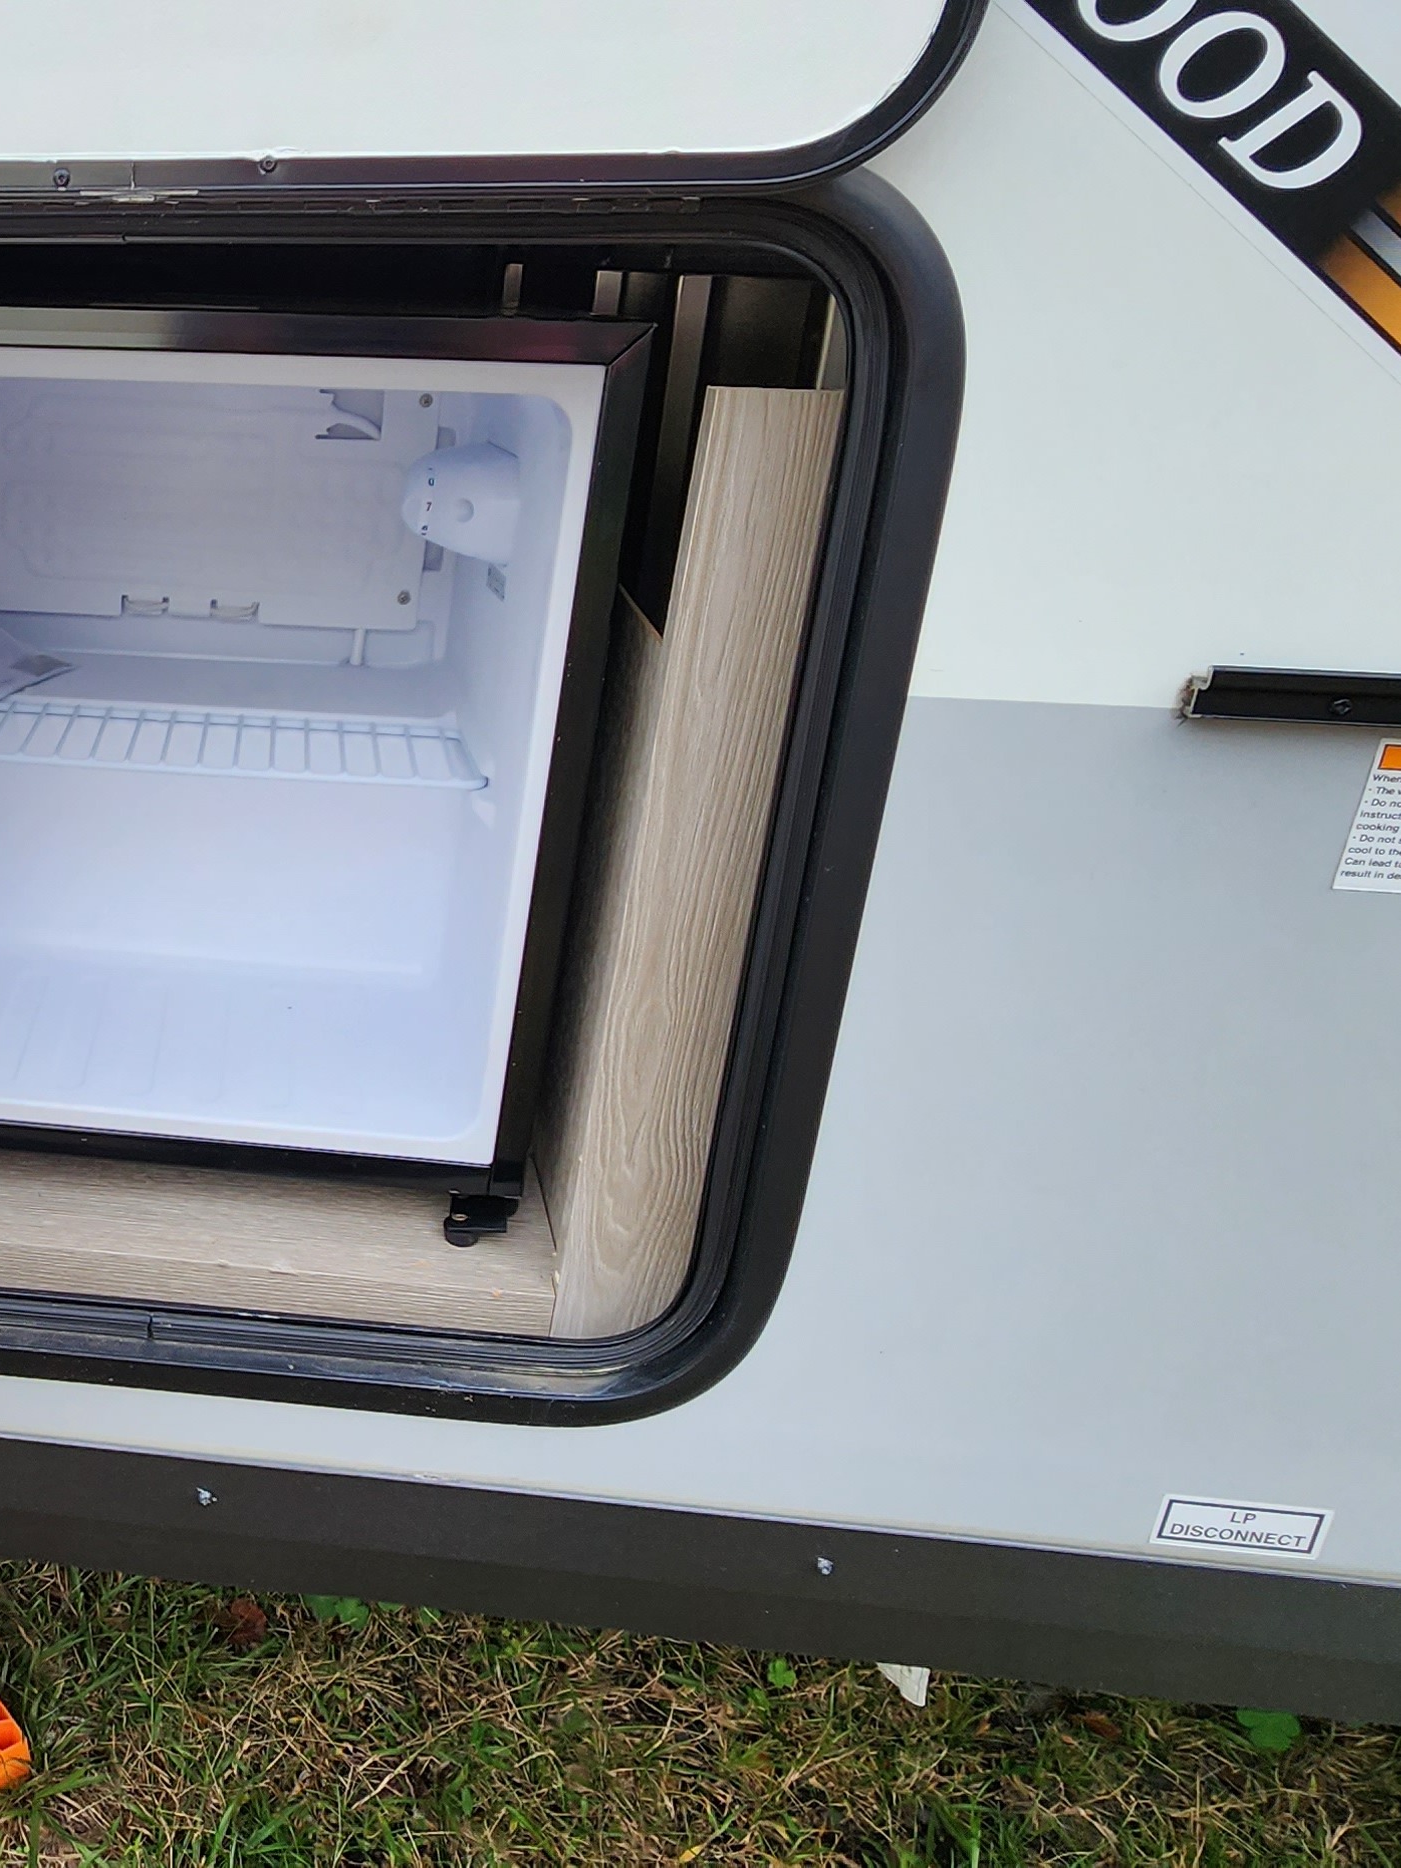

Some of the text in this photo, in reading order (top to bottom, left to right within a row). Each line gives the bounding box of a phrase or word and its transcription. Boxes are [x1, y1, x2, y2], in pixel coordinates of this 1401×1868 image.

[426, 502, 433, 511] 7
[1376, 786, 1395, 795] The
[1371, 798, 1386, 807] Do
[1356, 823, 1400, 834] cooking
[1359, 834, 1375, 843] Do
[1377, 836, 1396, 844] not
[1348, 846, 1372, 855] cool
[1374, 848, 1385, 856] to
[1344, 857, 1365, 866] Can
[1368, 858, 1392, 868] lead
[1340, 870, 1371, 879] result
[1373, 871, 1384, 879] in
[1230, 1511, 1257, 1524] LP
[1170, 1523, 1307, 1547] DISCONNECT
